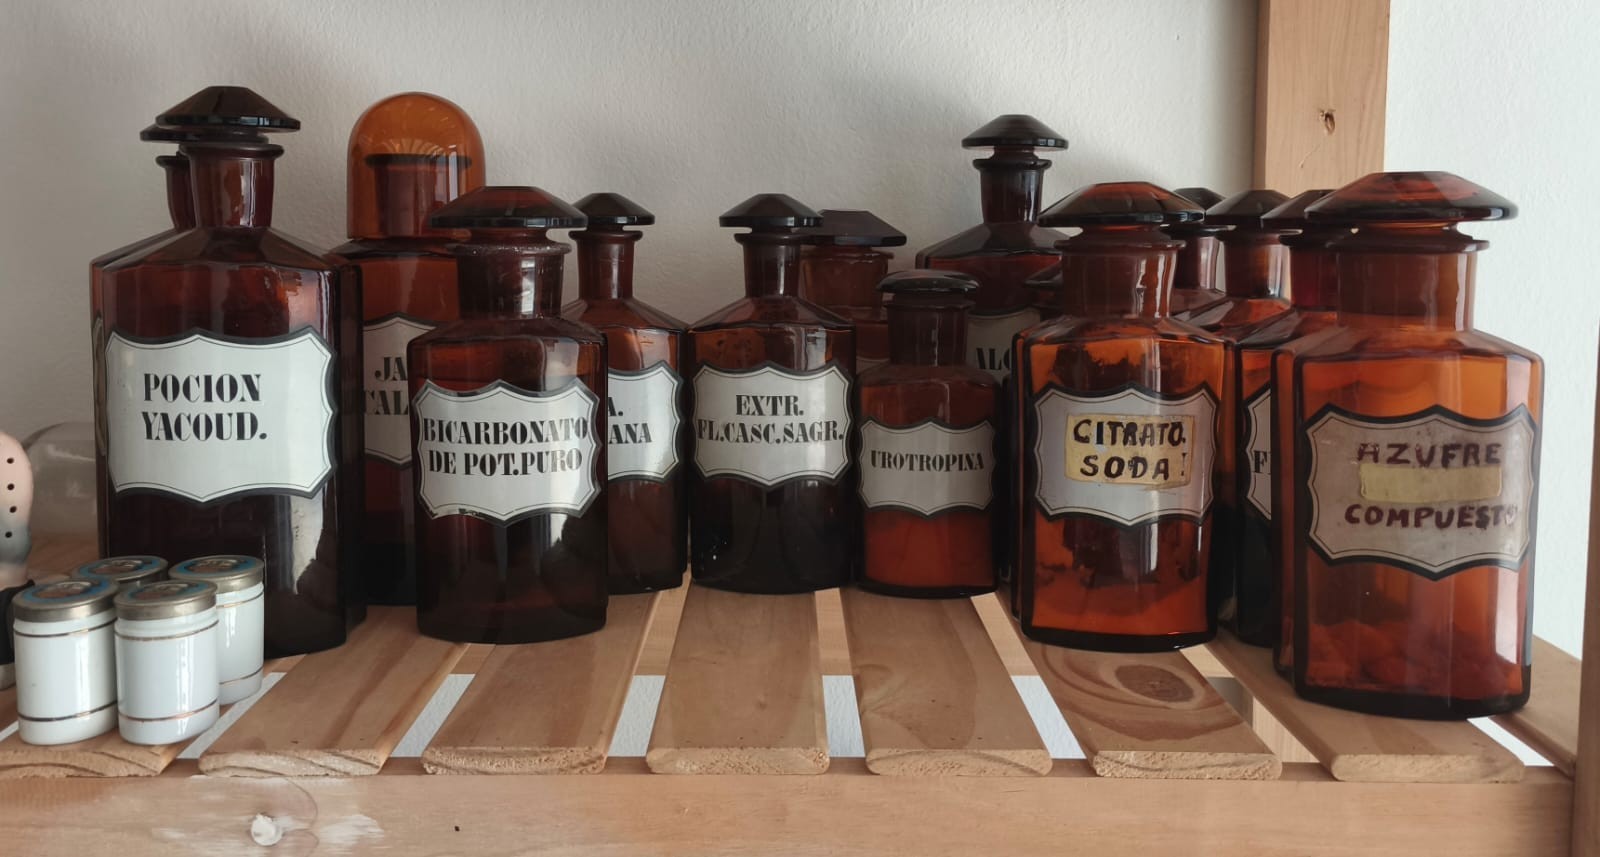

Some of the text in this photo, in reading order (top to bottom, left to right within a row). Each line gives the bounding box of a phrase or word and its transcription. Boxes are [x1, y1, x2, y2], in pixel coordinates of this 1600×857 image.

[143, 373, 262, 403] POCION
[736, 395, 804, 416] EXTR.
[141, 411, 268, 442] YACOUD.
[423, 416, 588, 445] BICARBONATO
[429, 450, 457, 475] DE
[870, 450, 985, 472] UROTROPINA
[1357, 443, 1501, 468] AZUFRE
